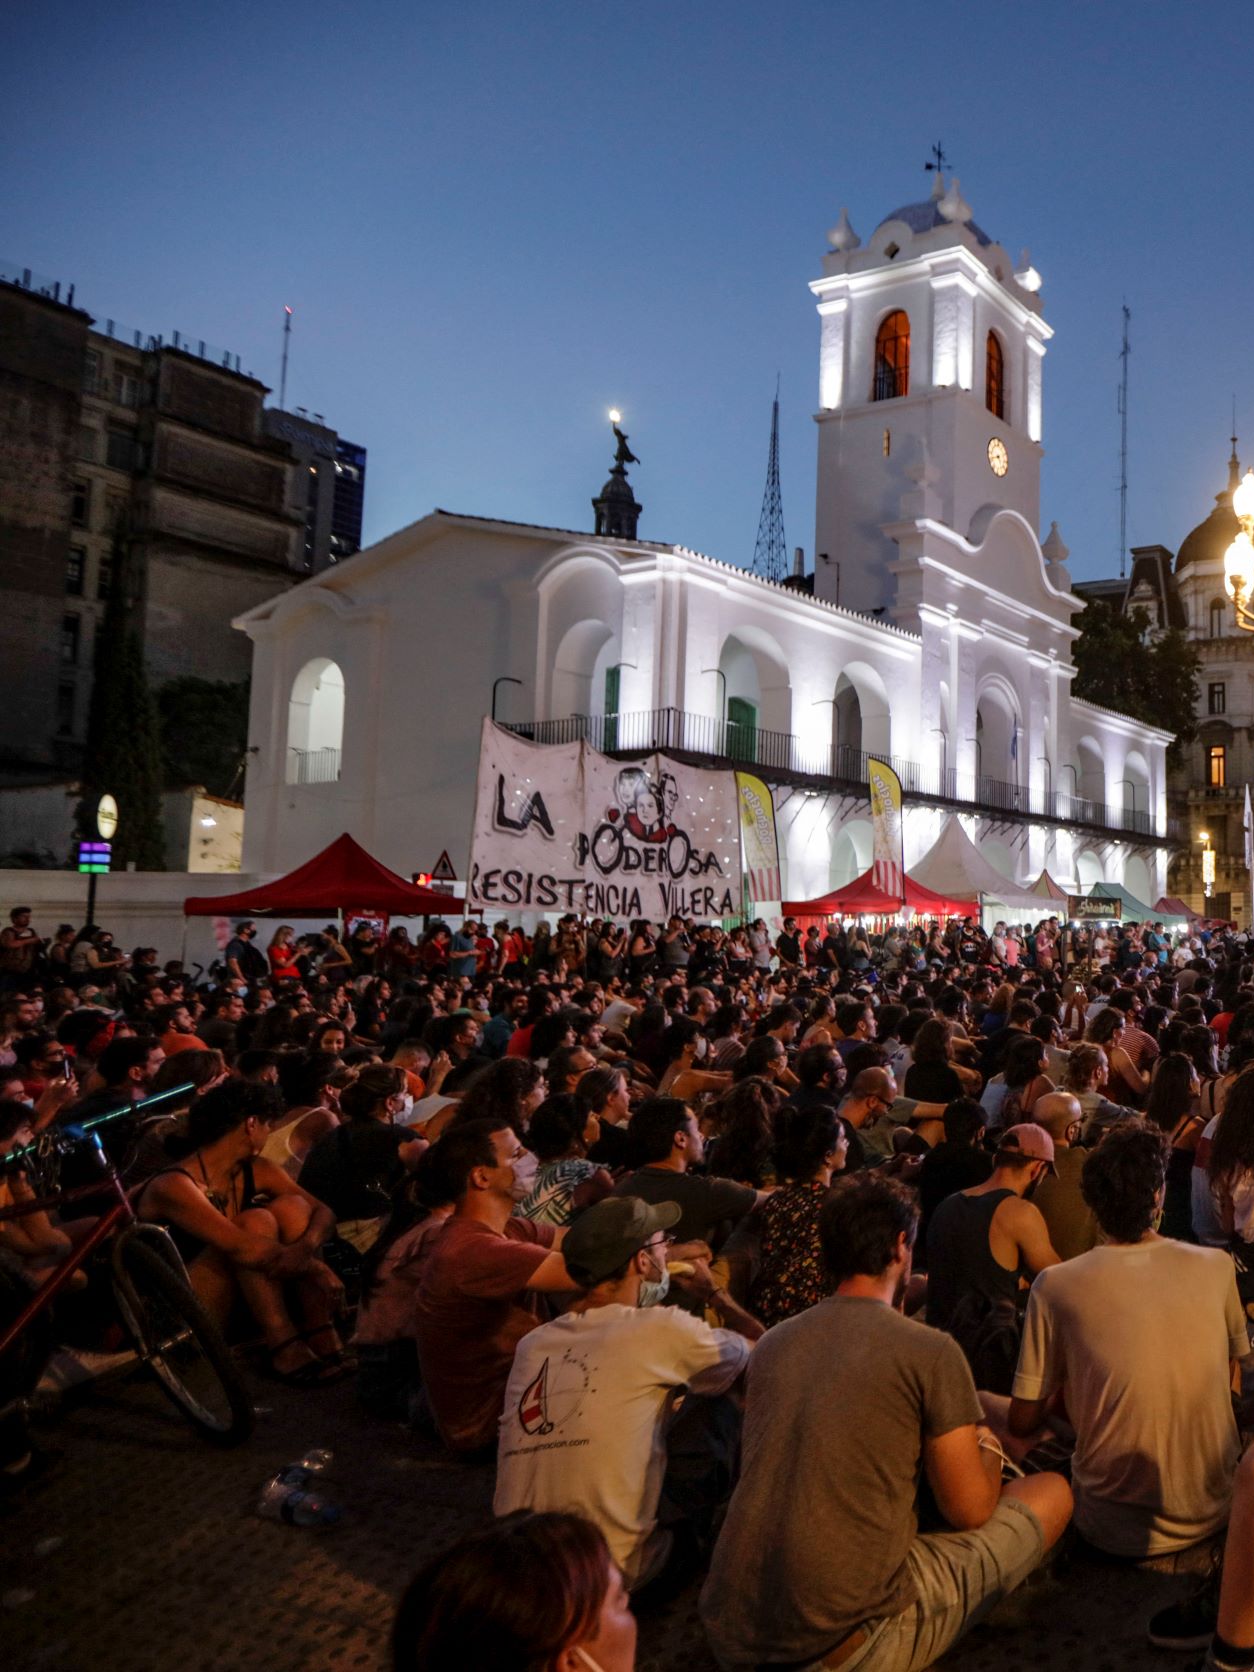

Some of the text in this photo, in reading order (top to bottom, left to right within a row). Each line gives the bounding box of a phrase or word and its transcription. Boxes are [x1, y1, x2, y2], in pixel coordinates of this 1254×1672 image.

[495, 773, 554, 836] LA
[578, 823, 723, 879] PODEROSA
[658, 880, 733, 917] VILLERA
